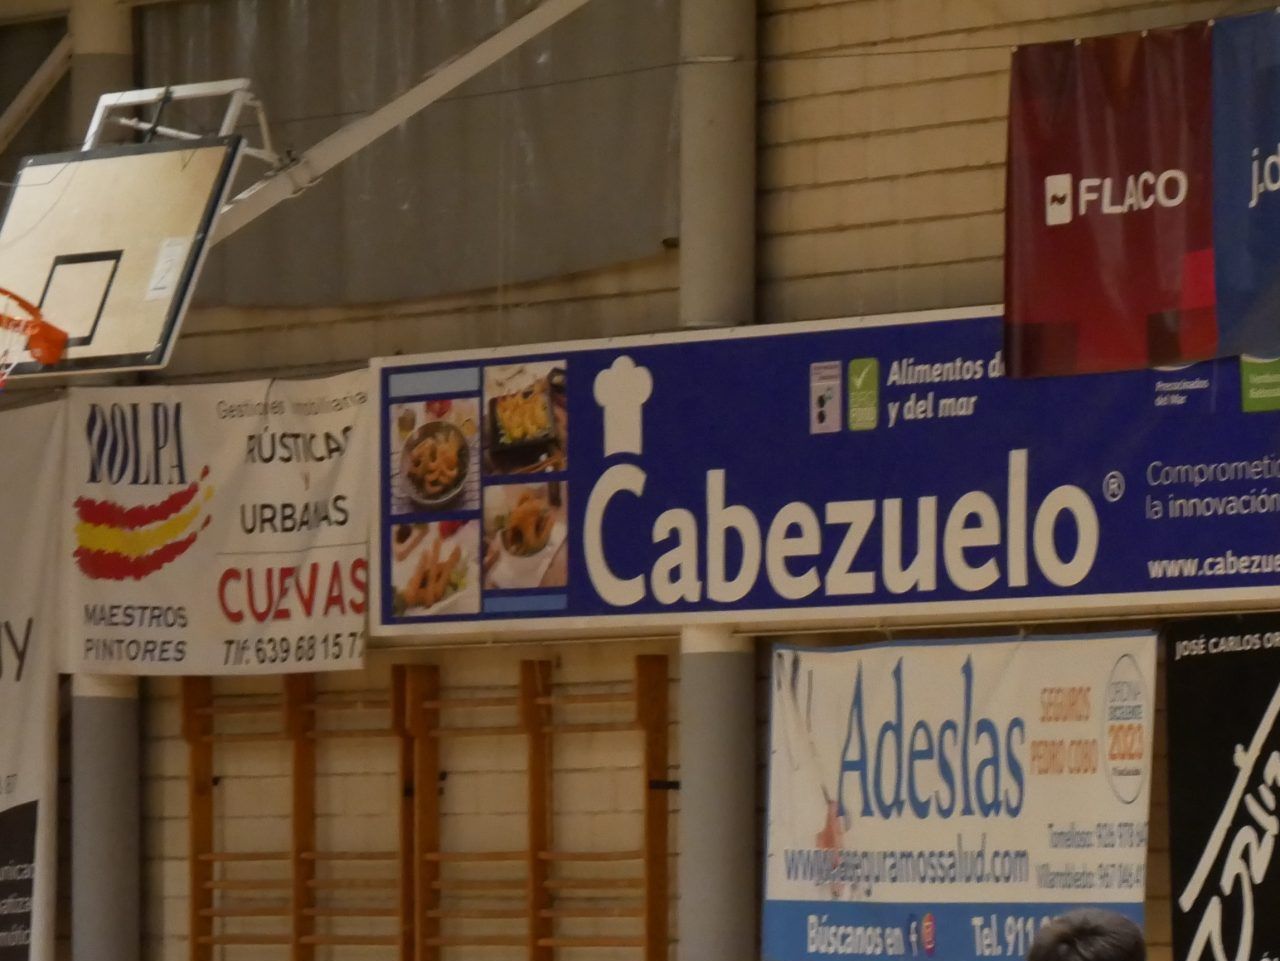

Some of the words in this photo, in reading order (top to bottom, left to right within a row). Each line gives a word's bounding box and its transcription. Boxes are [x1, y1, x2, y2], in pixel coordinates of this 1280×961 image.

[1078, 169, 1189, 216] FLACO
[886, 357, 985, 387] Alimentos
[987, 350, 1006, 377] d
[887, 401, 900, 429] y
[902, 392, 934, 421] del
[938, 396, 978, 418] mar
[1146, 494, 1163, 520] la
[582, 447, 1100, 607] Cabezuelo
[218, 558, 368, 624] CUEVAS
[84, 604, 189, 629] MAESTROS
[83, 637, 188, 663] PINTORES
[1174, 634, 1207, 661] JOSÉ
[1208, 633, 1261, 654] CARLOS
[838, 653, 1026, 820] Adeslas
[807, 913, 884, 956] Búscanos
[884, 926, 906, 956] en
